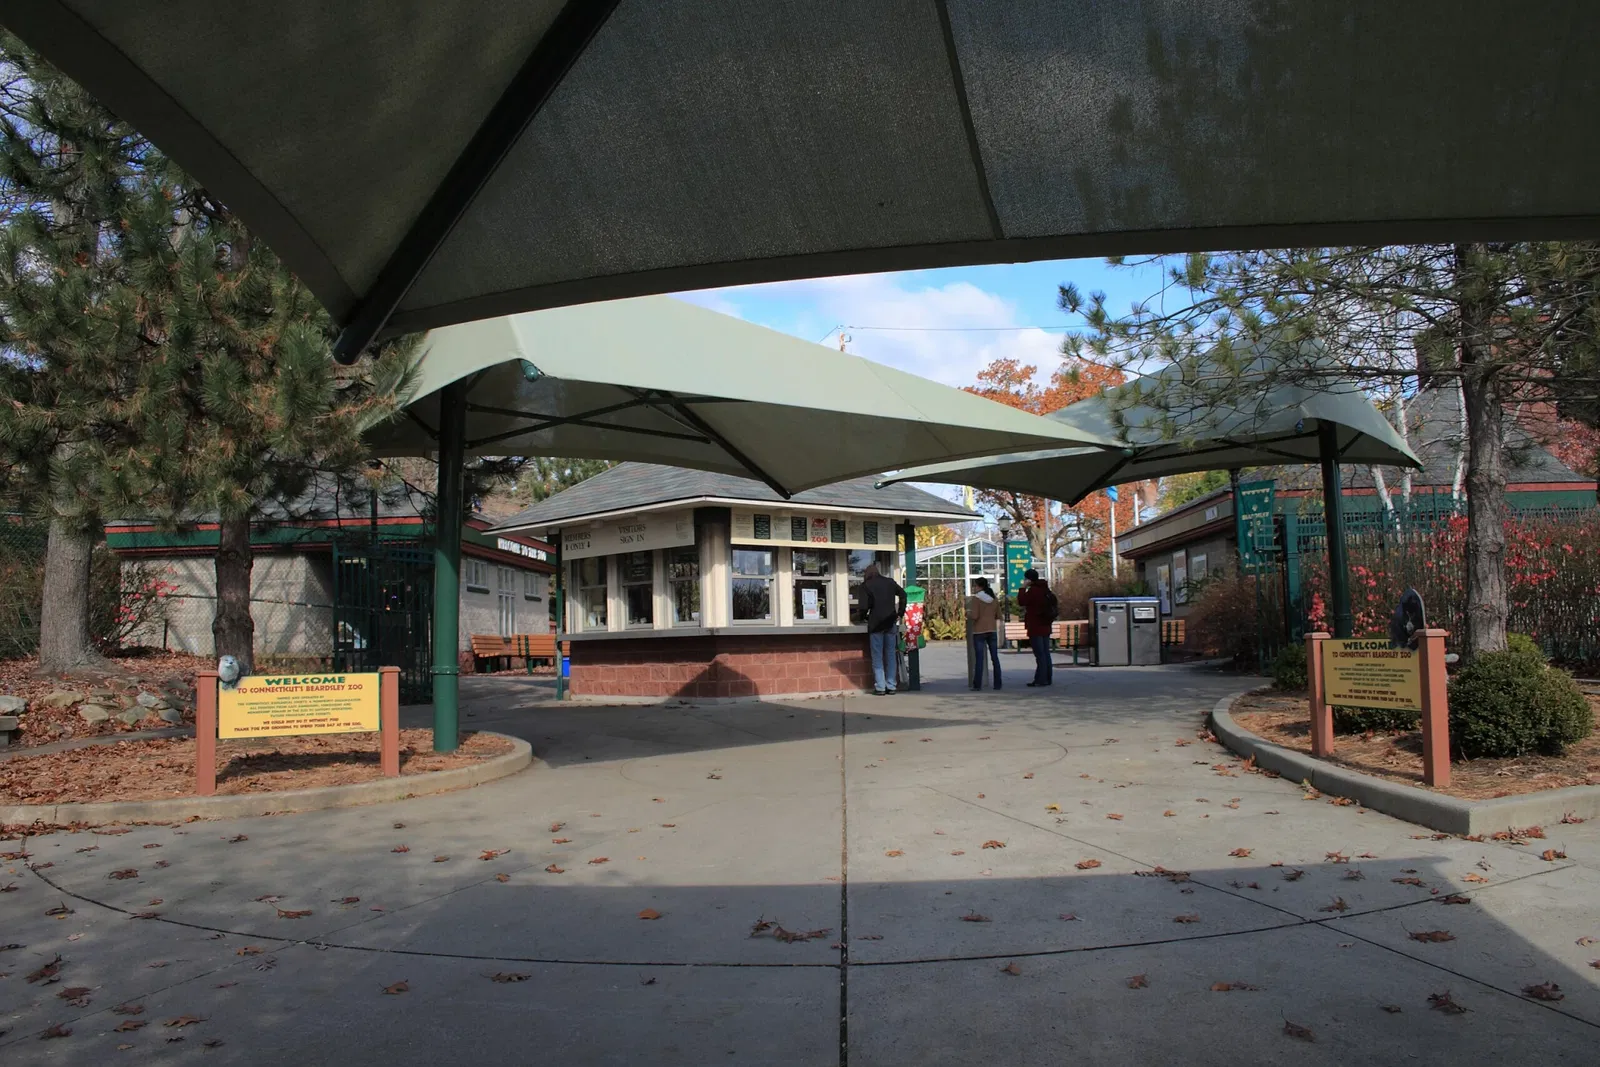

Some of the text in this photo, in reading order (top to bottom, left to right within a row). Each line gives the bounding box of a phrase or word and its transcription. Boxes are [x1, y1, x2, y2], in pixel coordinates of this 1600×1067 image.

[618, 524, 647, 534] VISITORS
[564, 531, 592, 542] MEMBERS
[619, 533, 645, 544] SIGN IN
[570, 542, 585, 551] ONLY
[265, 677, 345, 686] WELCOME
